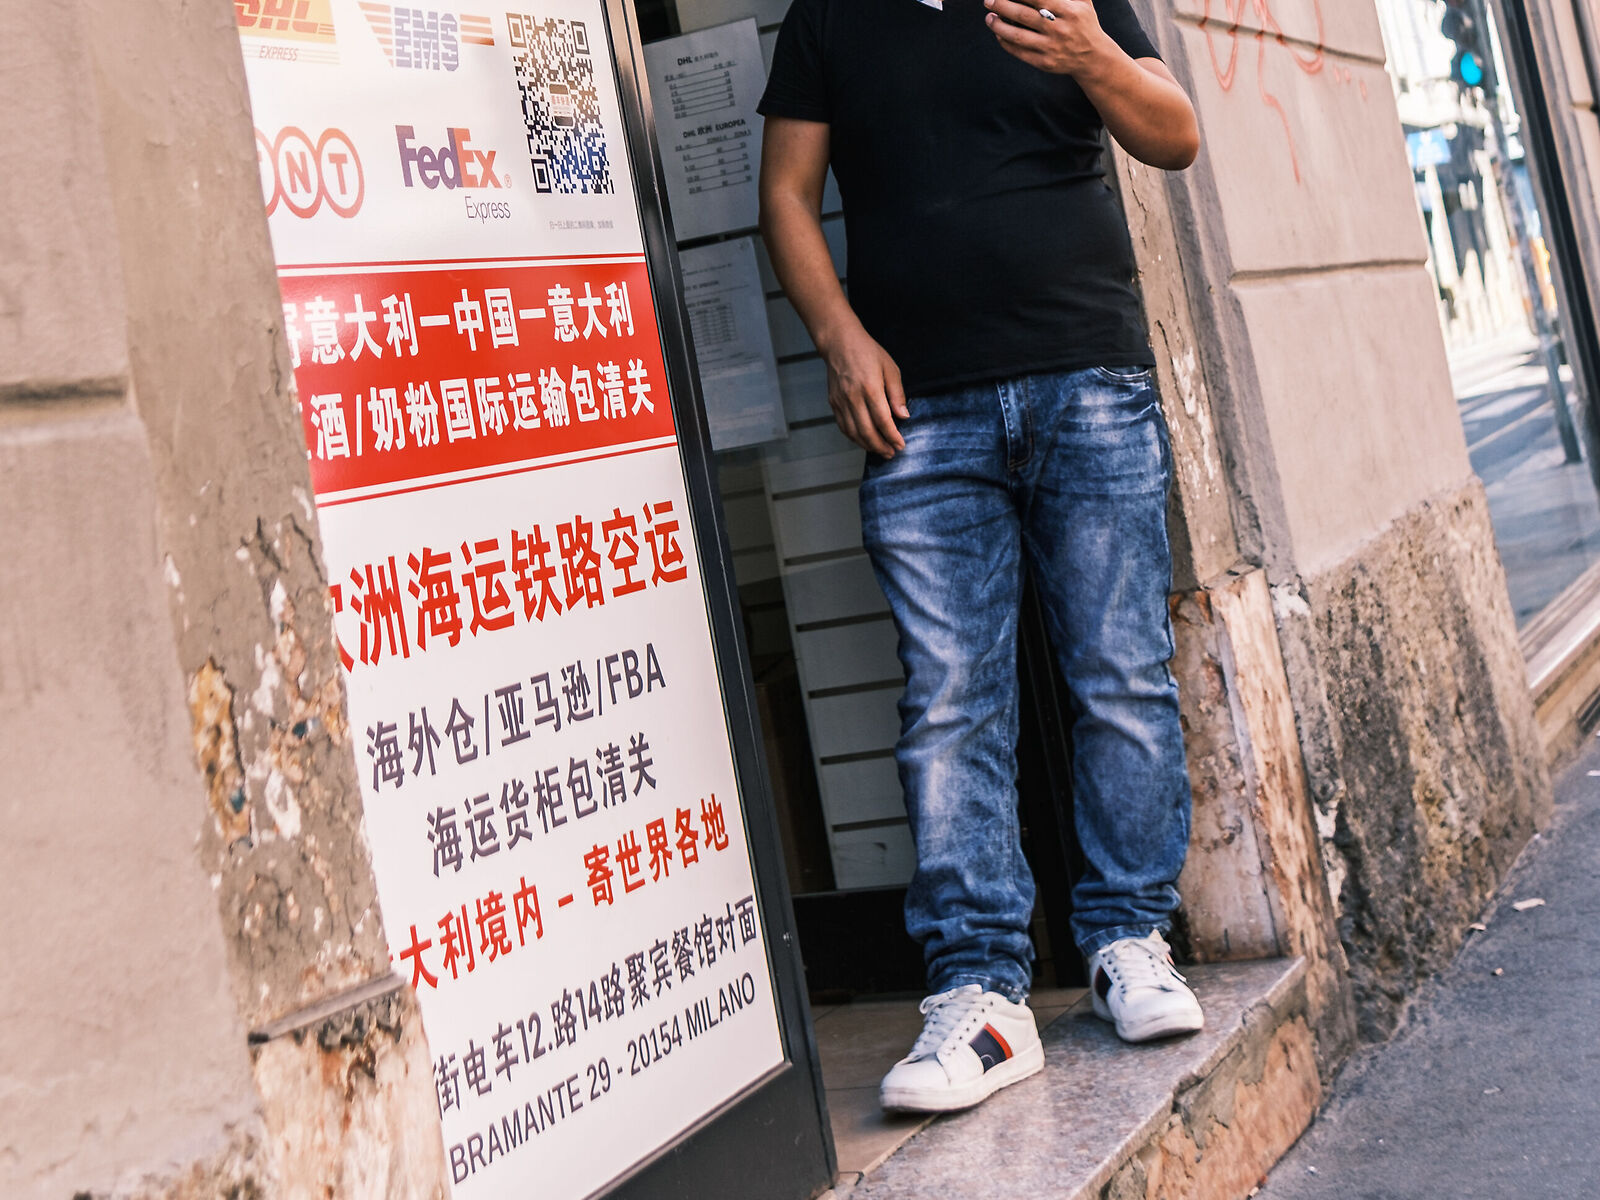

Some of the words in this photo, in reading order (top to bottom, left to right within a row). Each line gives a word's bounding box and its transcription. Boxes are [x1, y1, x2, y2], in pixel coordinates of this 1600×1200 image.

[258, 45, 300, 62] EXPRESS
[394, 7, 459, 72] EMS
[395, 125, 503, 190] FedEx
[464, 196, 511, 224] Express
[298, 358, 655, 461] 酒/奶粉国际运输包清关
[365, 642, 666, 792] 海外仓/亚马逊/FBA
[426, 731, 657, 878] 海运货柜包清关
[387, 875, 545, 991] 大利境内
[583, 793, 730, 906] 寄世界各地
[449, 1073, 584, 1185] BRAMANTE
[586, 1056, 612, 1101] 29
[627, 1014, 683, 1076] 20154
[685, 972, 755, 1040] MILANO
